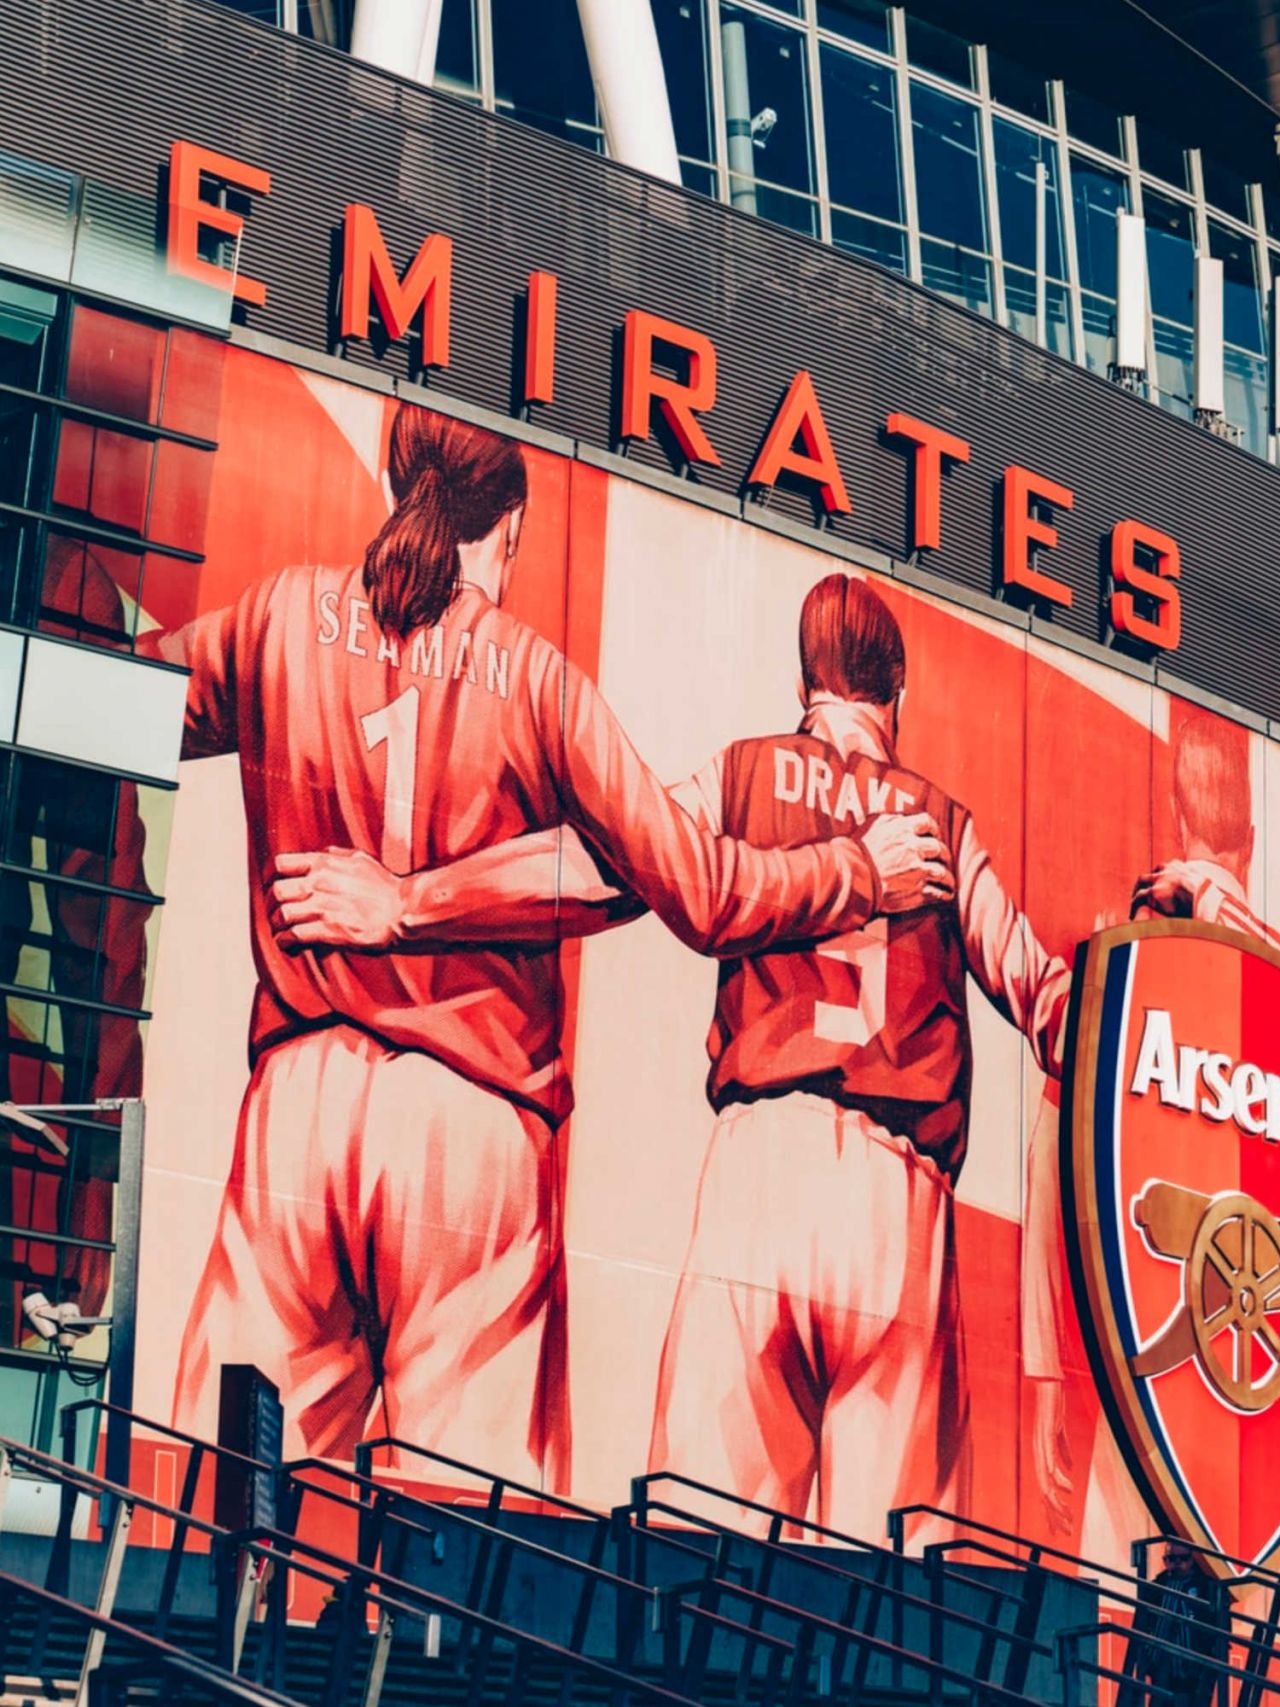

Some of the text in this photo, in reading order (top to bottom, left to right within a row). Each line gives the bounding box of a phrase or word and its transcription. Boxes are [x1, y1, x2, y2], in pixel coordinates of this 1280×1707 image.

[166, 139, 1182, 651] EMIRATES
[316, 590, 509, 699] SEAMAN
[359, 683, 422, 877] 1
